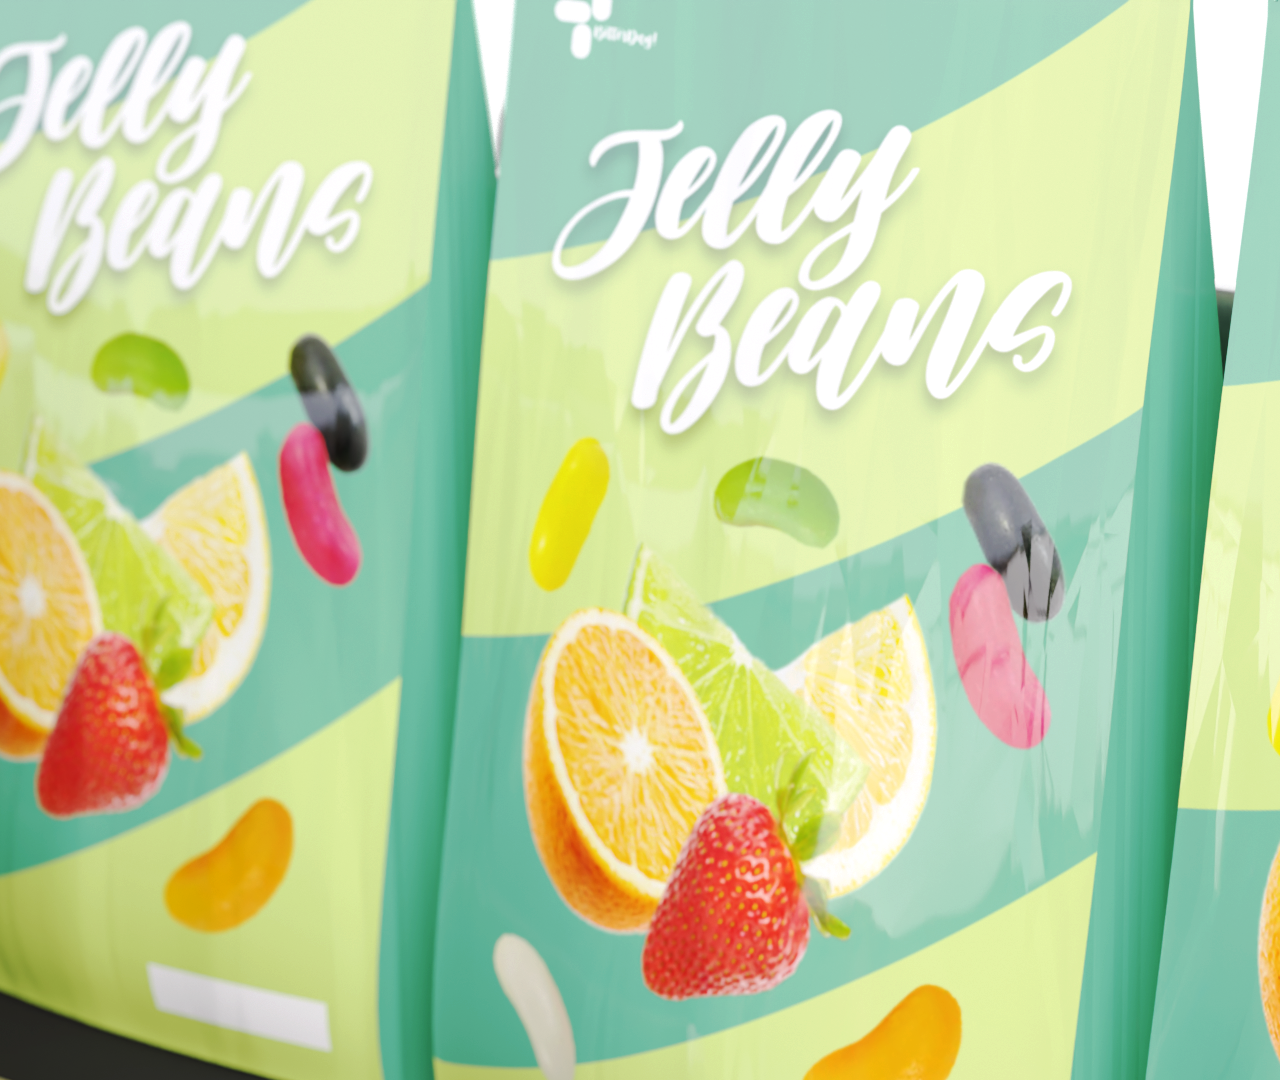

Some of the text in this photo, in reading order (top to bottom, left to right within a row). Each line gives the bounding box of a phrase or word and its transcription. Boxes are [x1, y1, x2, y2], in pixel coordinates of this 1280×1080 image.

[24, 156, 374, 316] Beans
[551, 109, 921, 291] Jelly
[631, 259, 1073, 435] Beans
